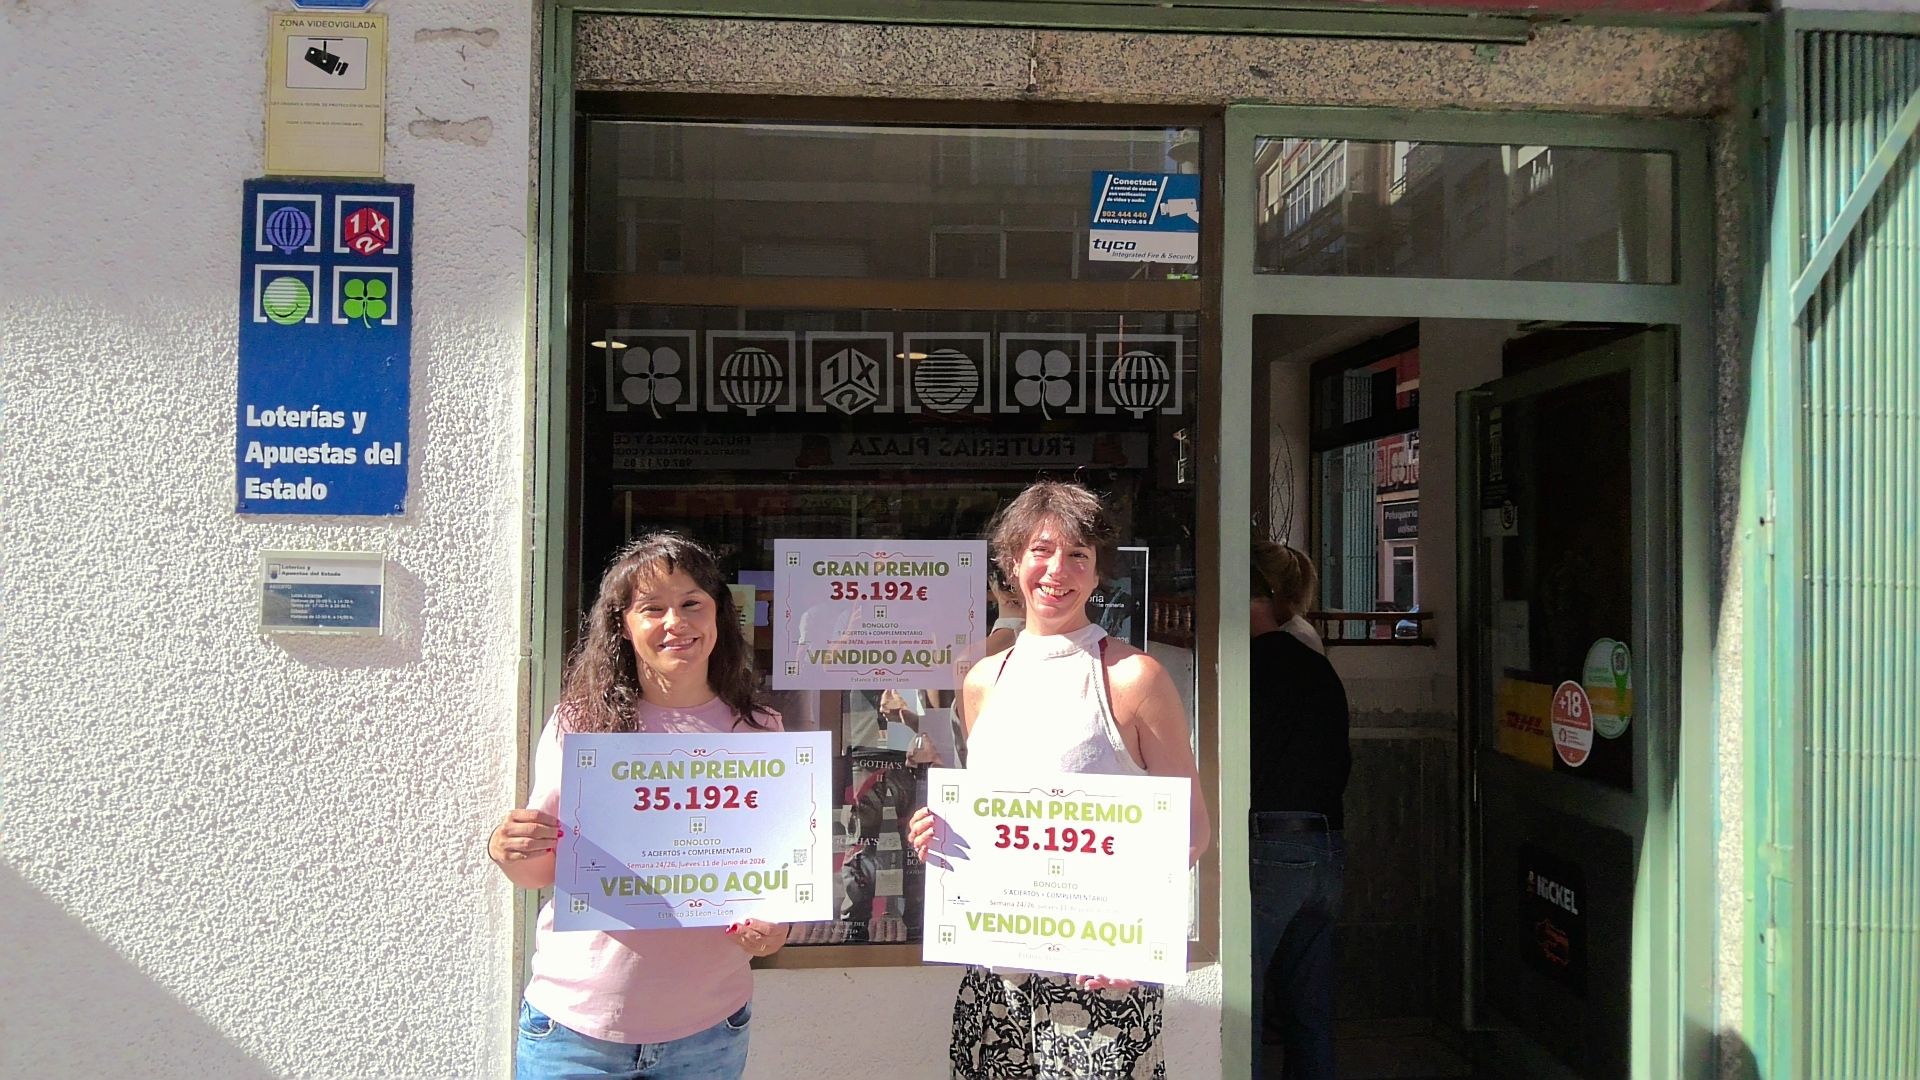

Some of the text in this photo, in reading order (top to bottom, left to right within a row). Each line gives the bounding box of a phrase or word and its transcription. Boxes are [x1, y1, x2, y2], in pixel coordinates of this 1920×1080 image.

[279, 19, 377, 29] ZONA VIDEOVIGILADA
[1113, 177, 1157, 186] Conectada
[1092, 238, 1137, 253] tyco
[246, 404, 367, 434] Loterías y
[244, 441, 402, 468] Apuestas del
[244, 478, 328, 500] Estado
[812, 560, 950, 577] GRAN PREMIO
[806, 644, 952, 668] VENDIDO AQUÍ
[1558, 690, 1582, 718] +18
[611, 758, 786, 780] GRAN PREMIO
[859, 759, 902, 771] GOTHA'S
[973, 798, 1142, 824] GRAN PREMIO
[673, 839, 721, 847] BONOLOTO
[647, 849, 681, 857] ACIERTOS
[688, 847, 752, 856] COMPLEMENTARIO
[600, 862, 789, 897] VENDIDO AQUÍ
[1033, 881, 1078, 890] BONOLOTO
[1009, 889, 1040, 897] ACIERTOS
[657, 911, 684, 919] Estaco
[966, 912, 1144, 947] VENDIDO AQUÍ
